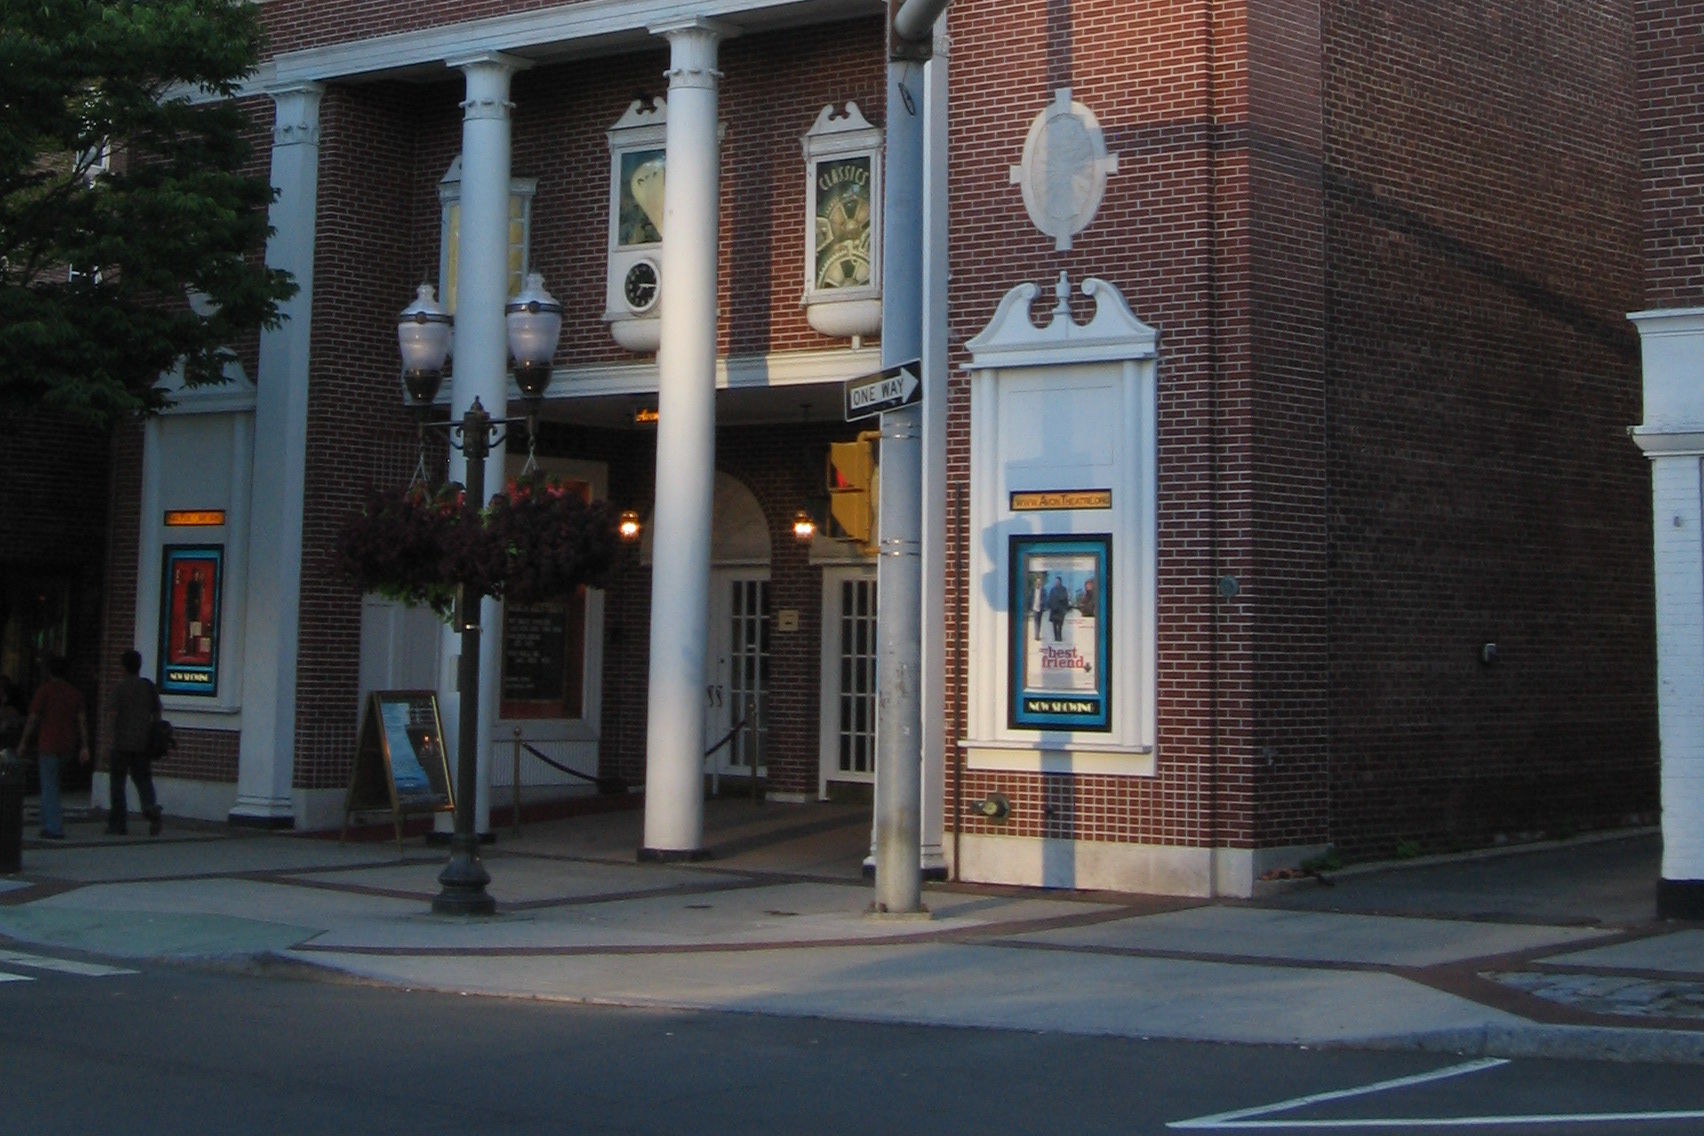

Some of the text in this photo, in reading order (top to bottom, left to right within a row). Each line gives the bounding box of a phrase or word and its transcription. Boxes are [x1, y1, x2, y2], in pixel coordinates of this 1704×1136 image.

[818, 165, 869, 191] CLASSICS
[853, 378, 904, 406] ONE WAY
[1047, 645, 1077, 659] best
[1041, 656, 1084, 669] friend
[1028, 701, 1094, 713] NOW SHOWING
